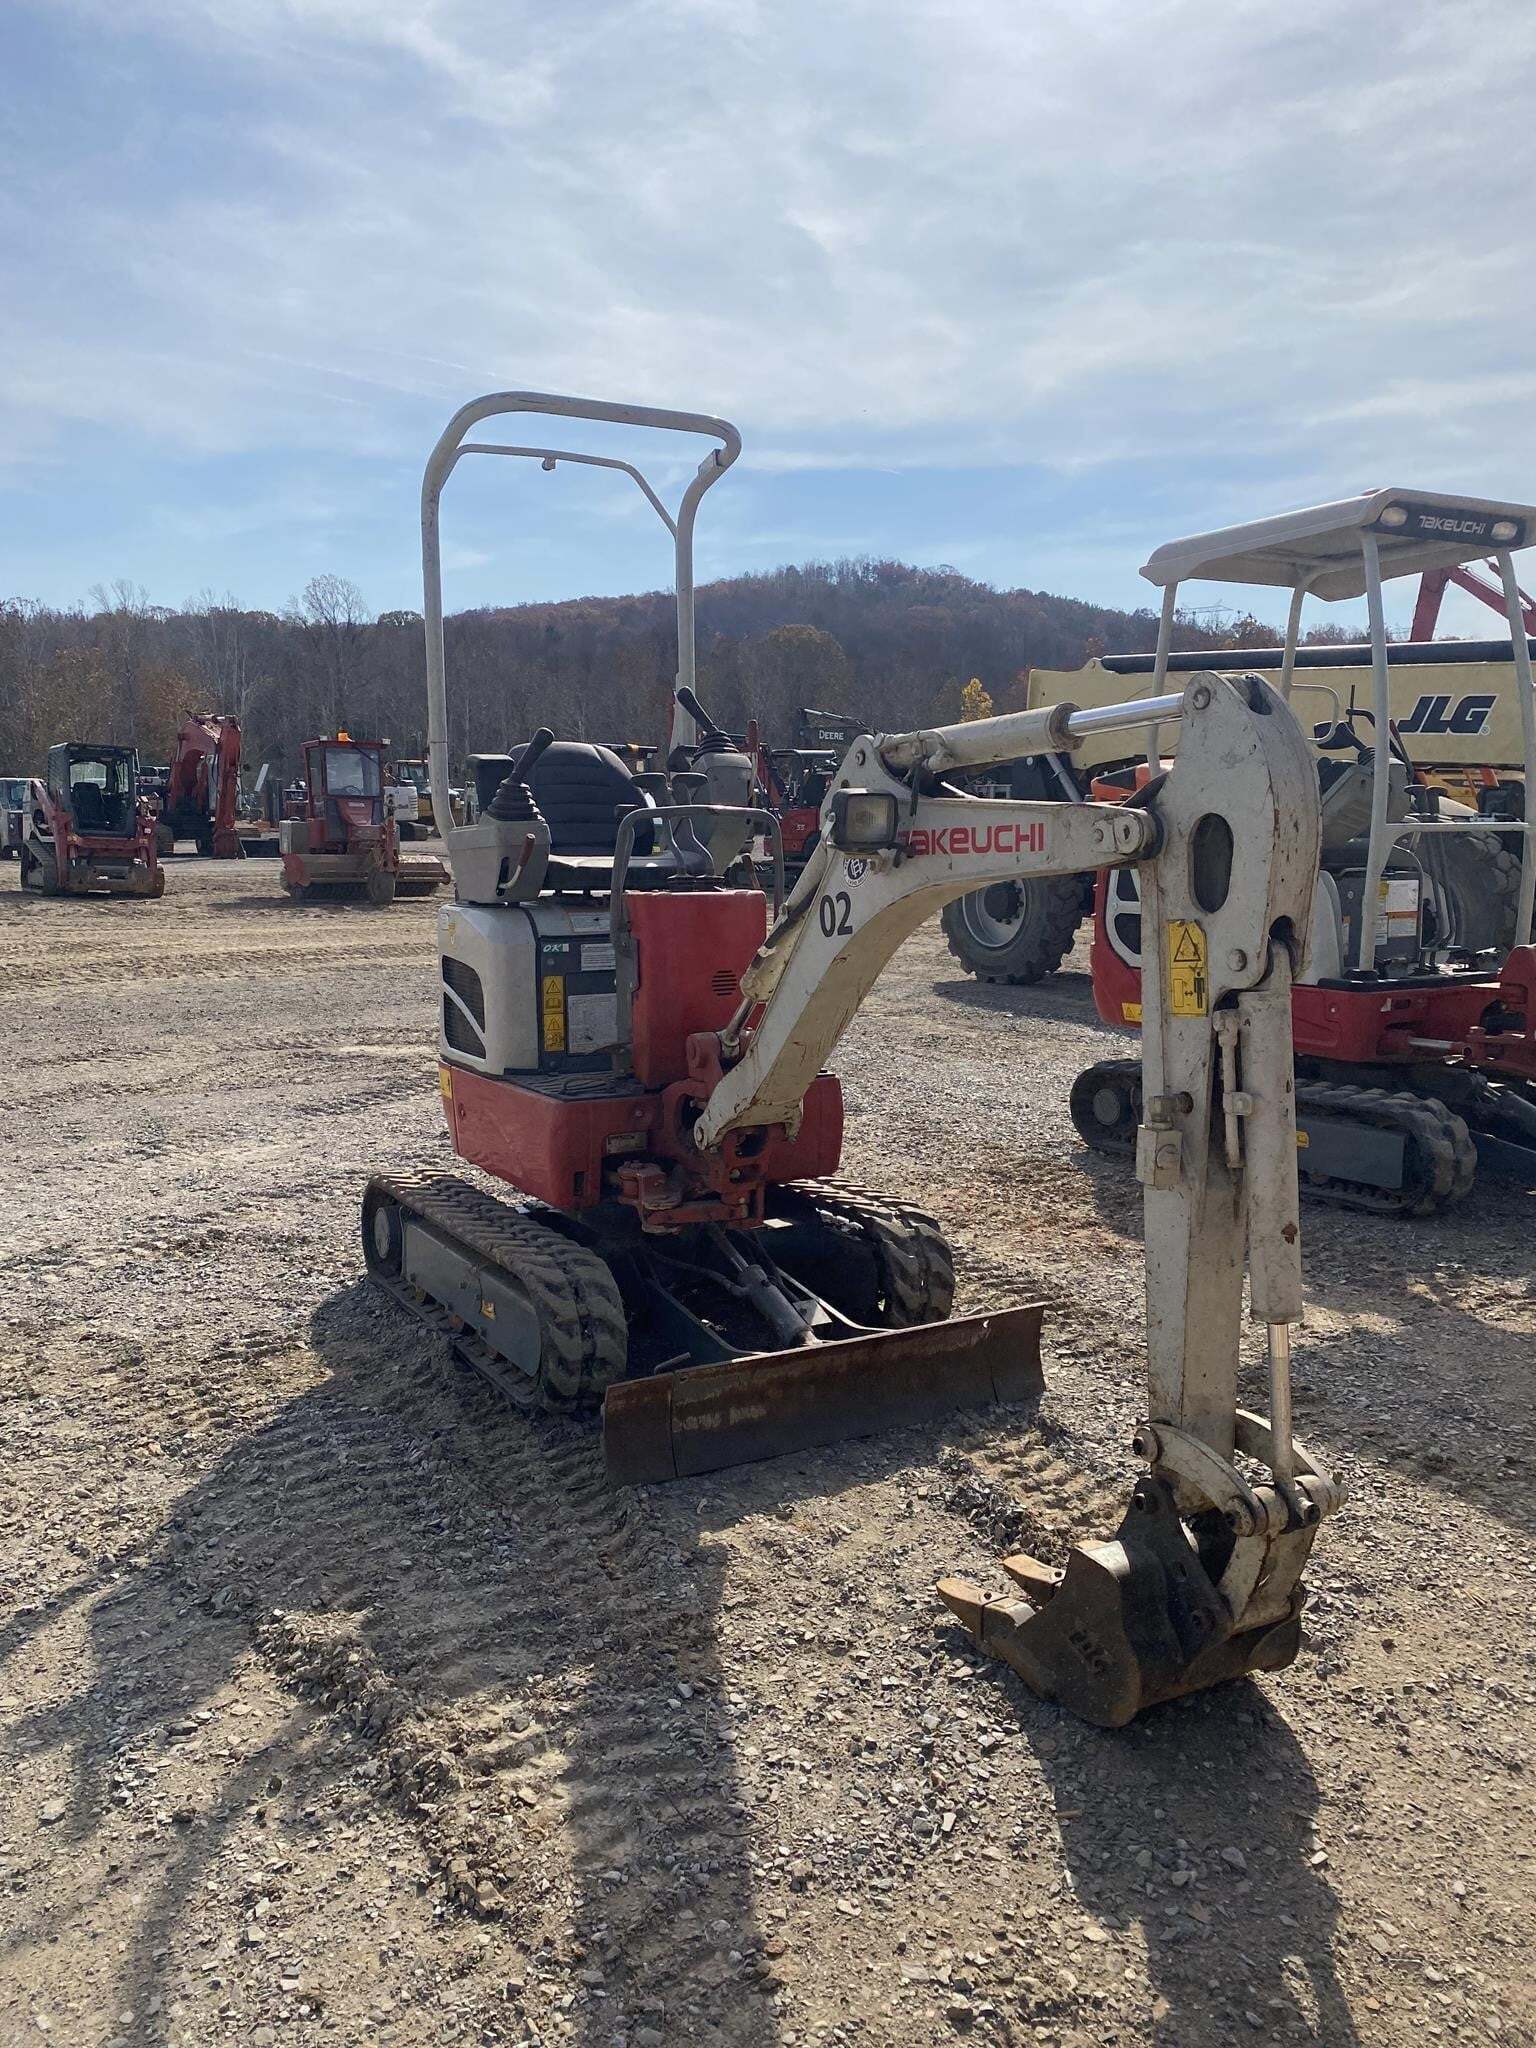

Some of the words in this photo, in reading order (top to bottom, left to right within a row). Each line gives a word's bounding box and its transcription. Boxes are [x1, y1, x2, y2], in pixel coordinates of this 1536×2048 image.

[818, 729, 845, 741] DEERE
[1396, 694, 1499, 735] JLG
[820, 891, 853, 938] 02
